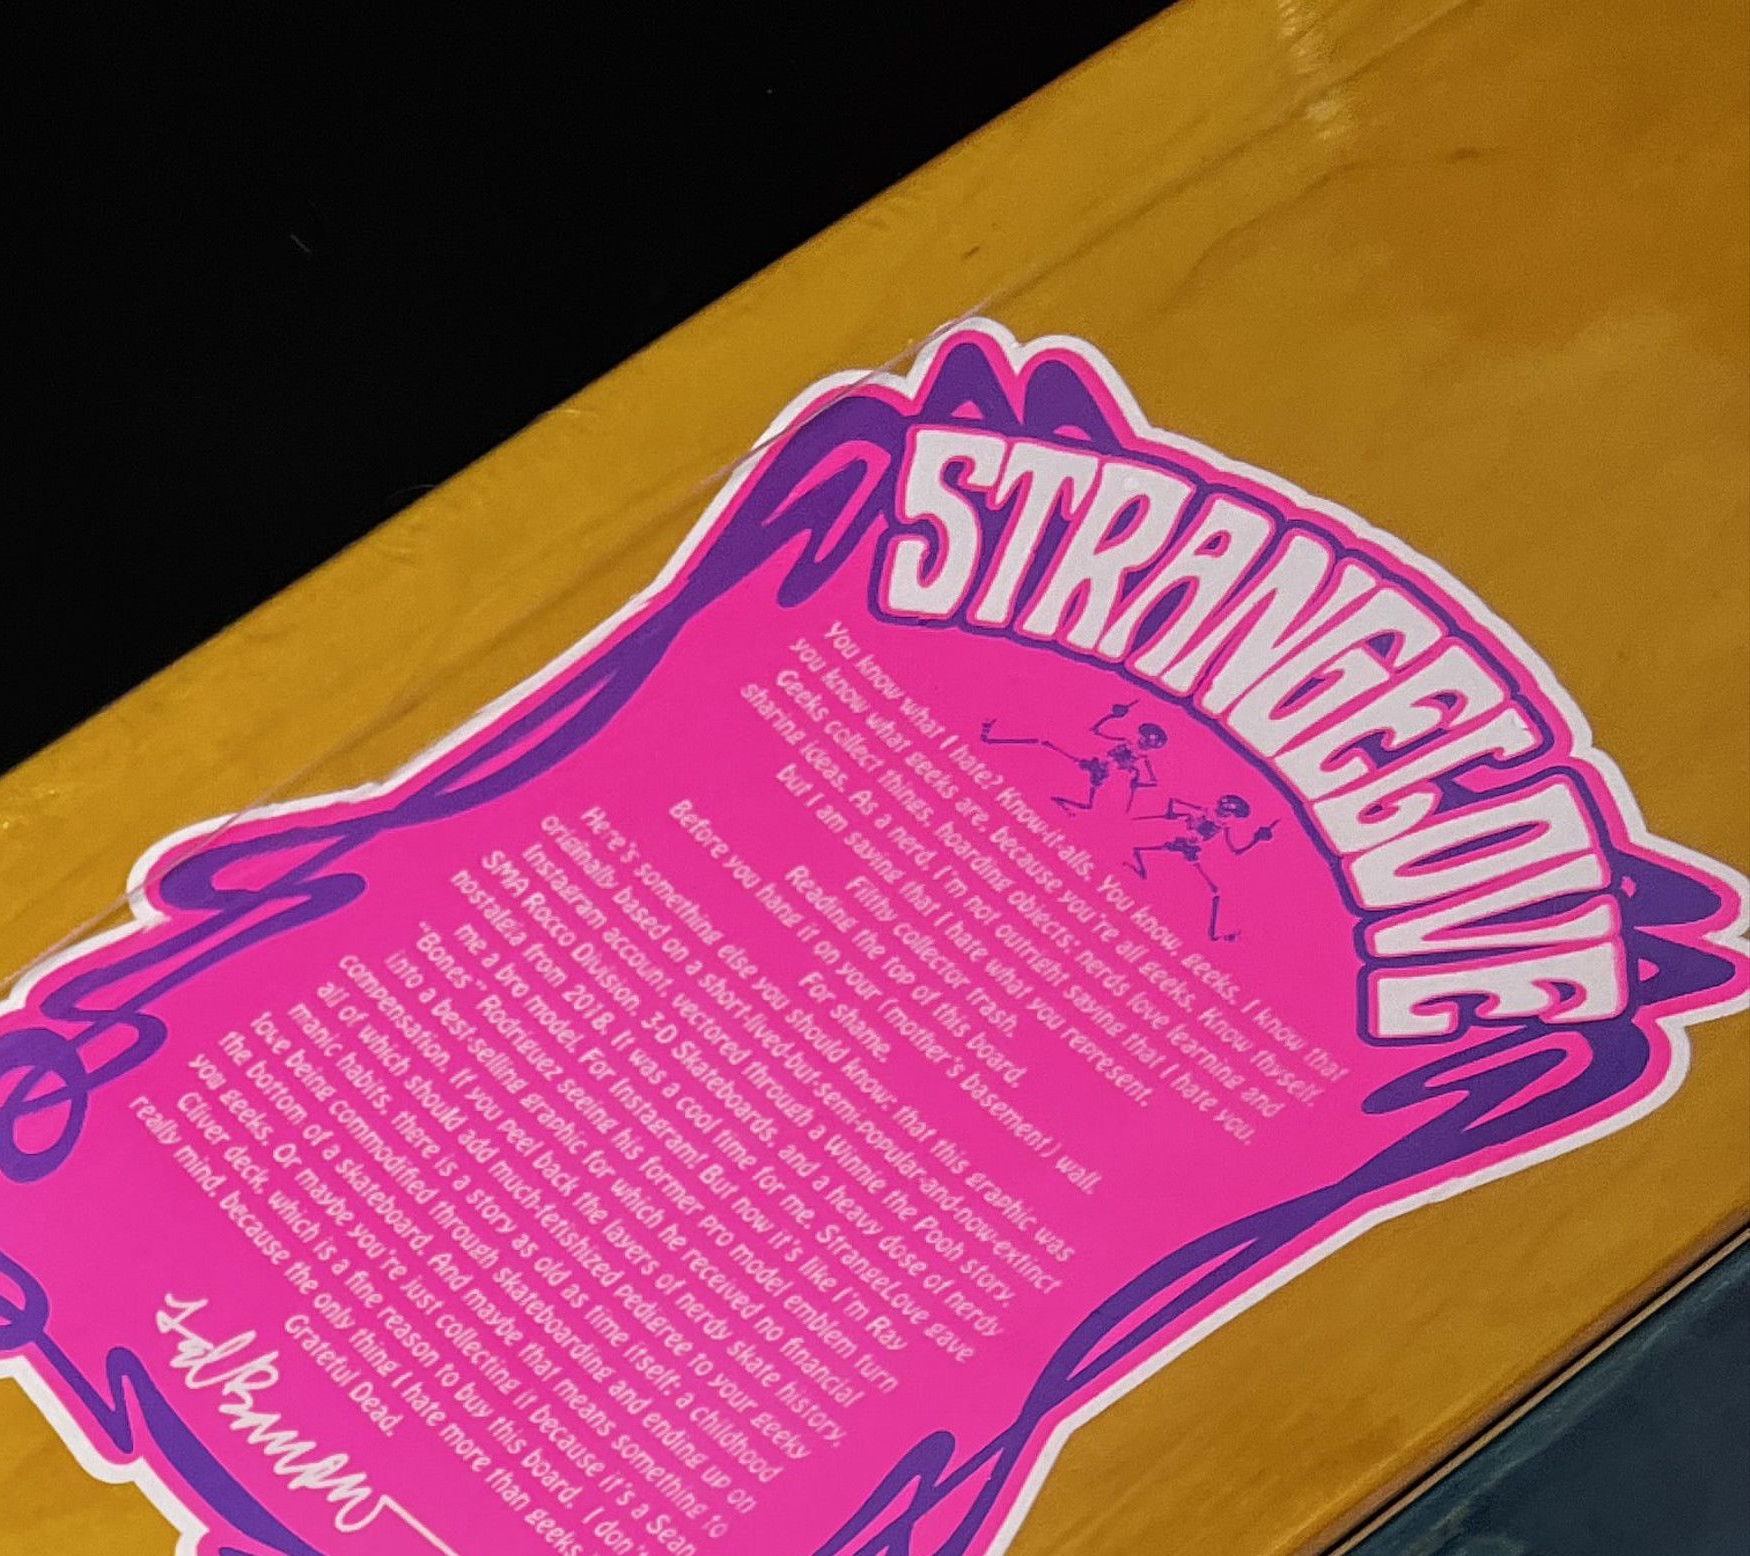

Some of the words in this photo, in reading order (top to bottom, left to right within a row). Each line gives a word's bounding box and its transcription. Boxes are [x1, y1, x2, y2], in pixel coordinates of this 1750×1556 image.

[886, 427, 1626, 1038] STRANGELOVE
[610, 885, 672, 941] based
[660, 936, 690, 963] on
[683, 958, 704, 976] a
[667, 797, 730, 860] Before
[721, 853, 761, 890] you
[753, 881, 804, 928] hang
[795, 924, 820, 943] it
[812, 939, 841, 965] on
[833, 960, 883, 1001] your
[958, 1071, 1062, 1158] basement)
[774, 761, 814, 797] but
[803, 791, 825, 808] I
[814, 803, 849, 834] am
[842, 830, 905, 884] saying
[899, 880, 941, 917] that
[932, 910, 954, 927] I
[943, 919, 989, 962] hate
[984, 957, 1034, 1000] what
[1025, 996, 1066, 1031] you
[783, 863, 858, 933] Reading
[850, 927, 886, 960] the
[880, 955, 916, 985] top
[909, 984, 942, 1006] of
[931, 1001, 971, 1038] this
[797, 970, 837, 1003] For
[843, 874, 898, 922] Filthy
[891, 921, 971, 989] collector
[315, 980, 349, 1008] all
[336, 1004, 369, 1028] of
[357, 1022, 410, 1077] which
[402, 1073, 468, 1132] should
[456, 1127, 499, 1164] add
[487, 1158, 625, 1288] much-fetishized
[612, 1282, 694, 1356] pedigree
[686, 1351, 714, 1377] to
[706, 1371, 759, 1413] your
[748, 1410, 811, 1460] geeky
[452, 922, 488, 956] me
[480, 951, 500, 969] a
[493, 961, 530, 998] bro
[576, 1046, 617, 1081] For
[607, 1076, 708, 1169] Instagram!
[697, 1162, 739, 1200] But
[729, 1195, 775, 1233] now
[797, 1254, 838, 1293] like
[864, 1314, 908, 1351] Ray
[474, 993, 564, 1081] Rodriguez
[556, 1077, 618, 1134] seeing
[610, 1127, 644, 1161] his
[637, 1155, 705, 1215] former
[696, 1212, 735, 1247] pro
[727, 1242, 793, 1297] model
[782, 1293, 858, 1359] emblem
[852, 1352, 899, 1394] turn
[520, 942, 568, 987] from
[609, 1028, 636, 1052] It
[627, 1046, 667, 1085] was
[660, 1081, 681, 1099] a
[674, 1095, 722, 1134] cool
[711, 1128, 758, 1170] time
[750, 1165, 787, 1195] for
[814, 1223, 930, 1325] StrangeLove
[922, 1321, 975, 1363] gave
[283, 1312, 360, 1388] Grateful
